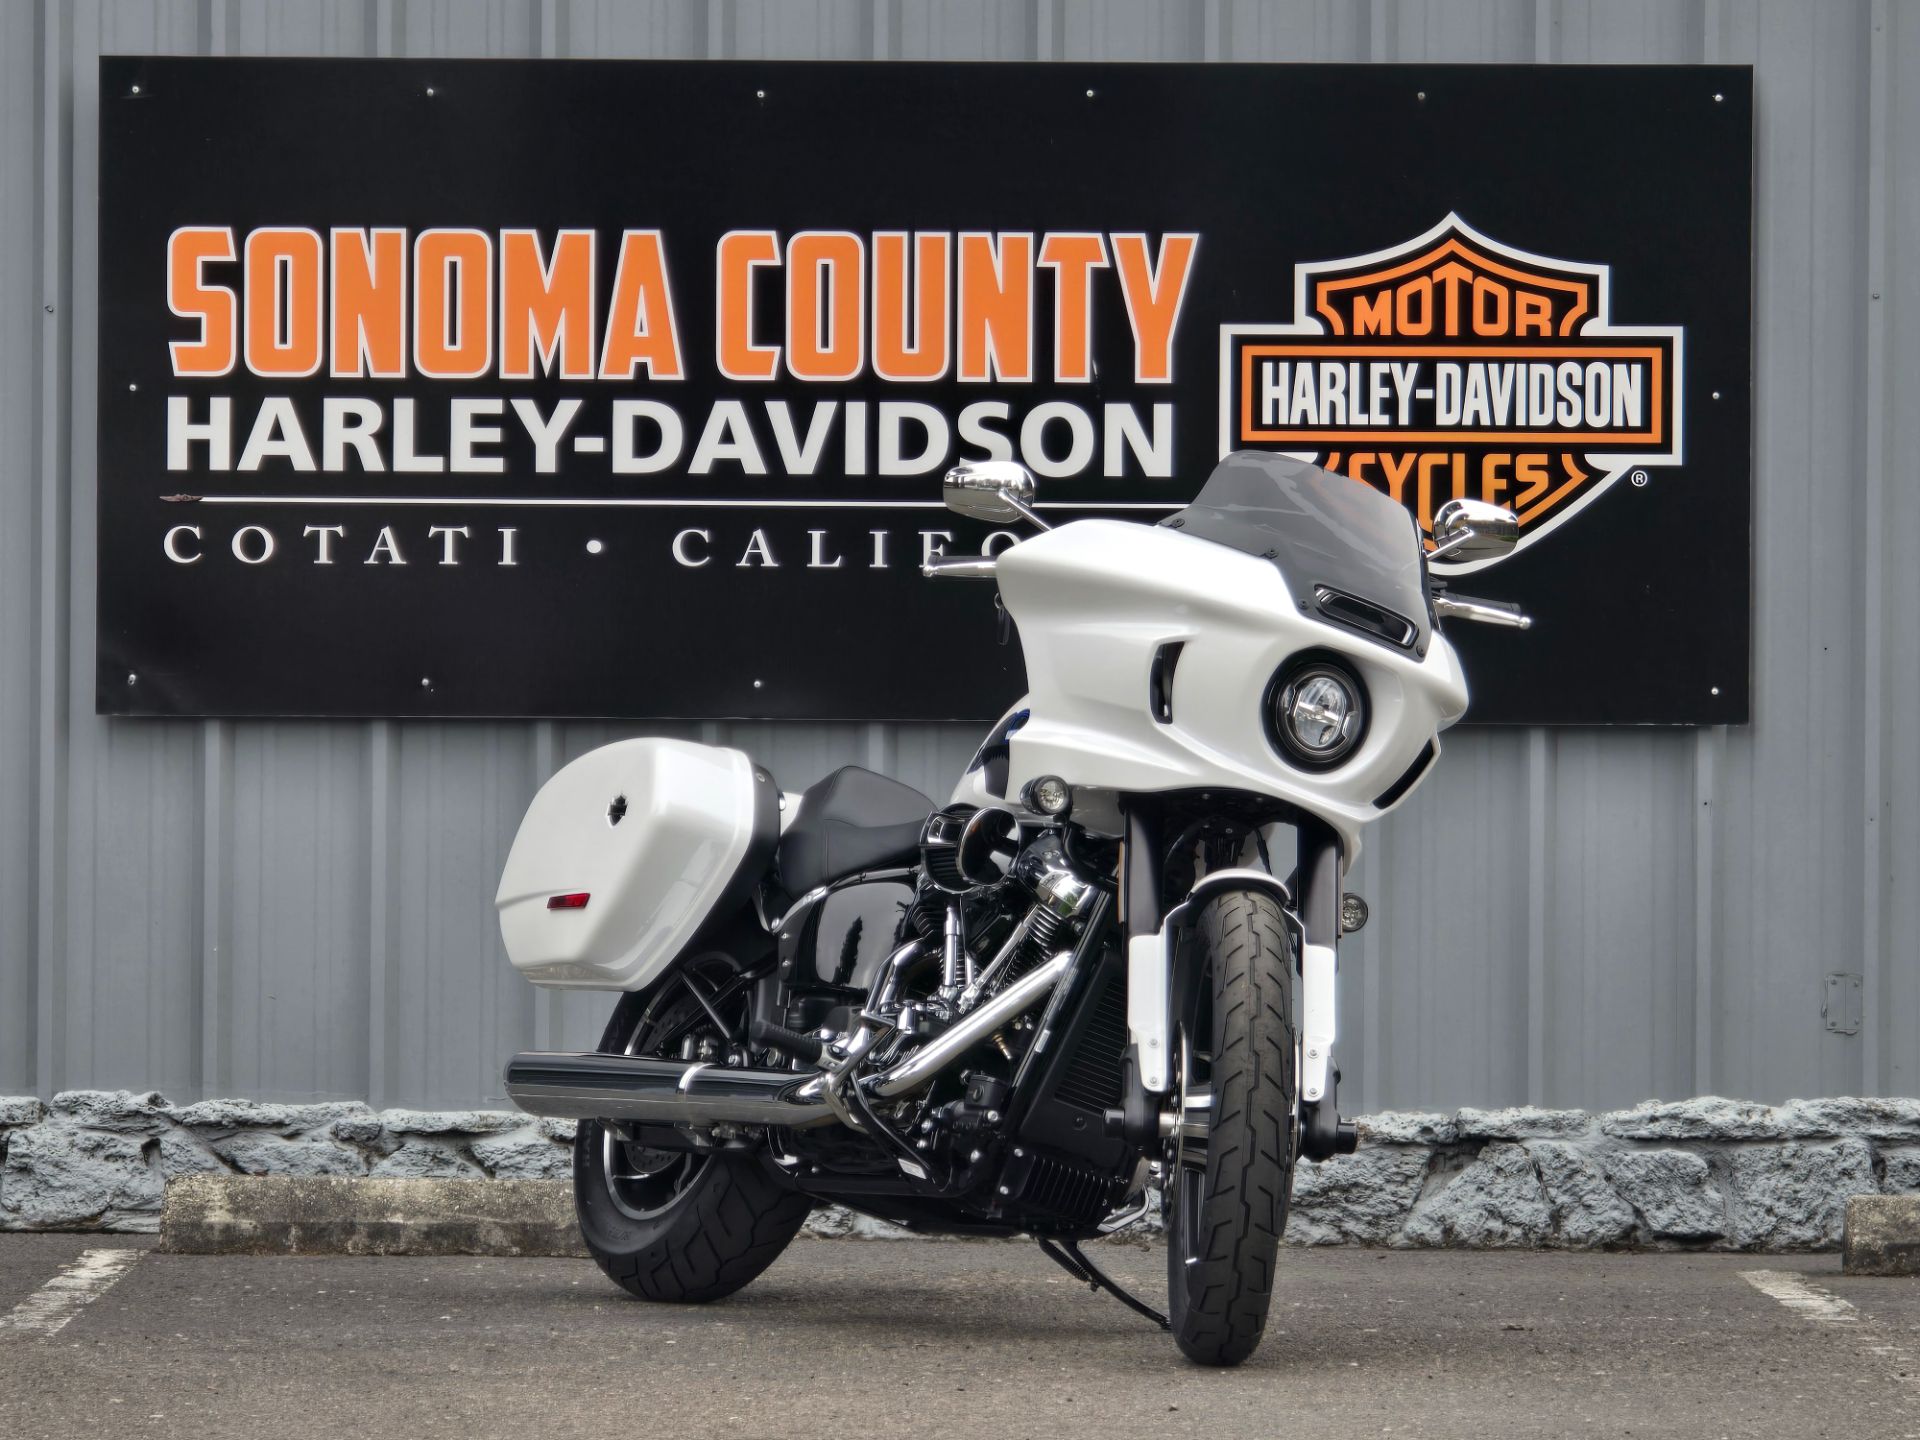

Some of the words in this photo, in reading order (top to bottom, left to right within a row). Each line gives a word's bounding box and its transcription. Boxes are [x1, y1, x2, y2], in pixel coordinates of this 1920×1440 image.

[167, 226, 686, 381] SONOMA
[715, 229, 1200, 384] COUNTY
[1353, 261, 1552, 337] MOTOR
[1262, 361, 1642, 428] HARLEY-DAVIDSON
[166, 396, 1173, 478] HARLEY-DAVIDSON
[163, 525, 518, 567] COTATI
